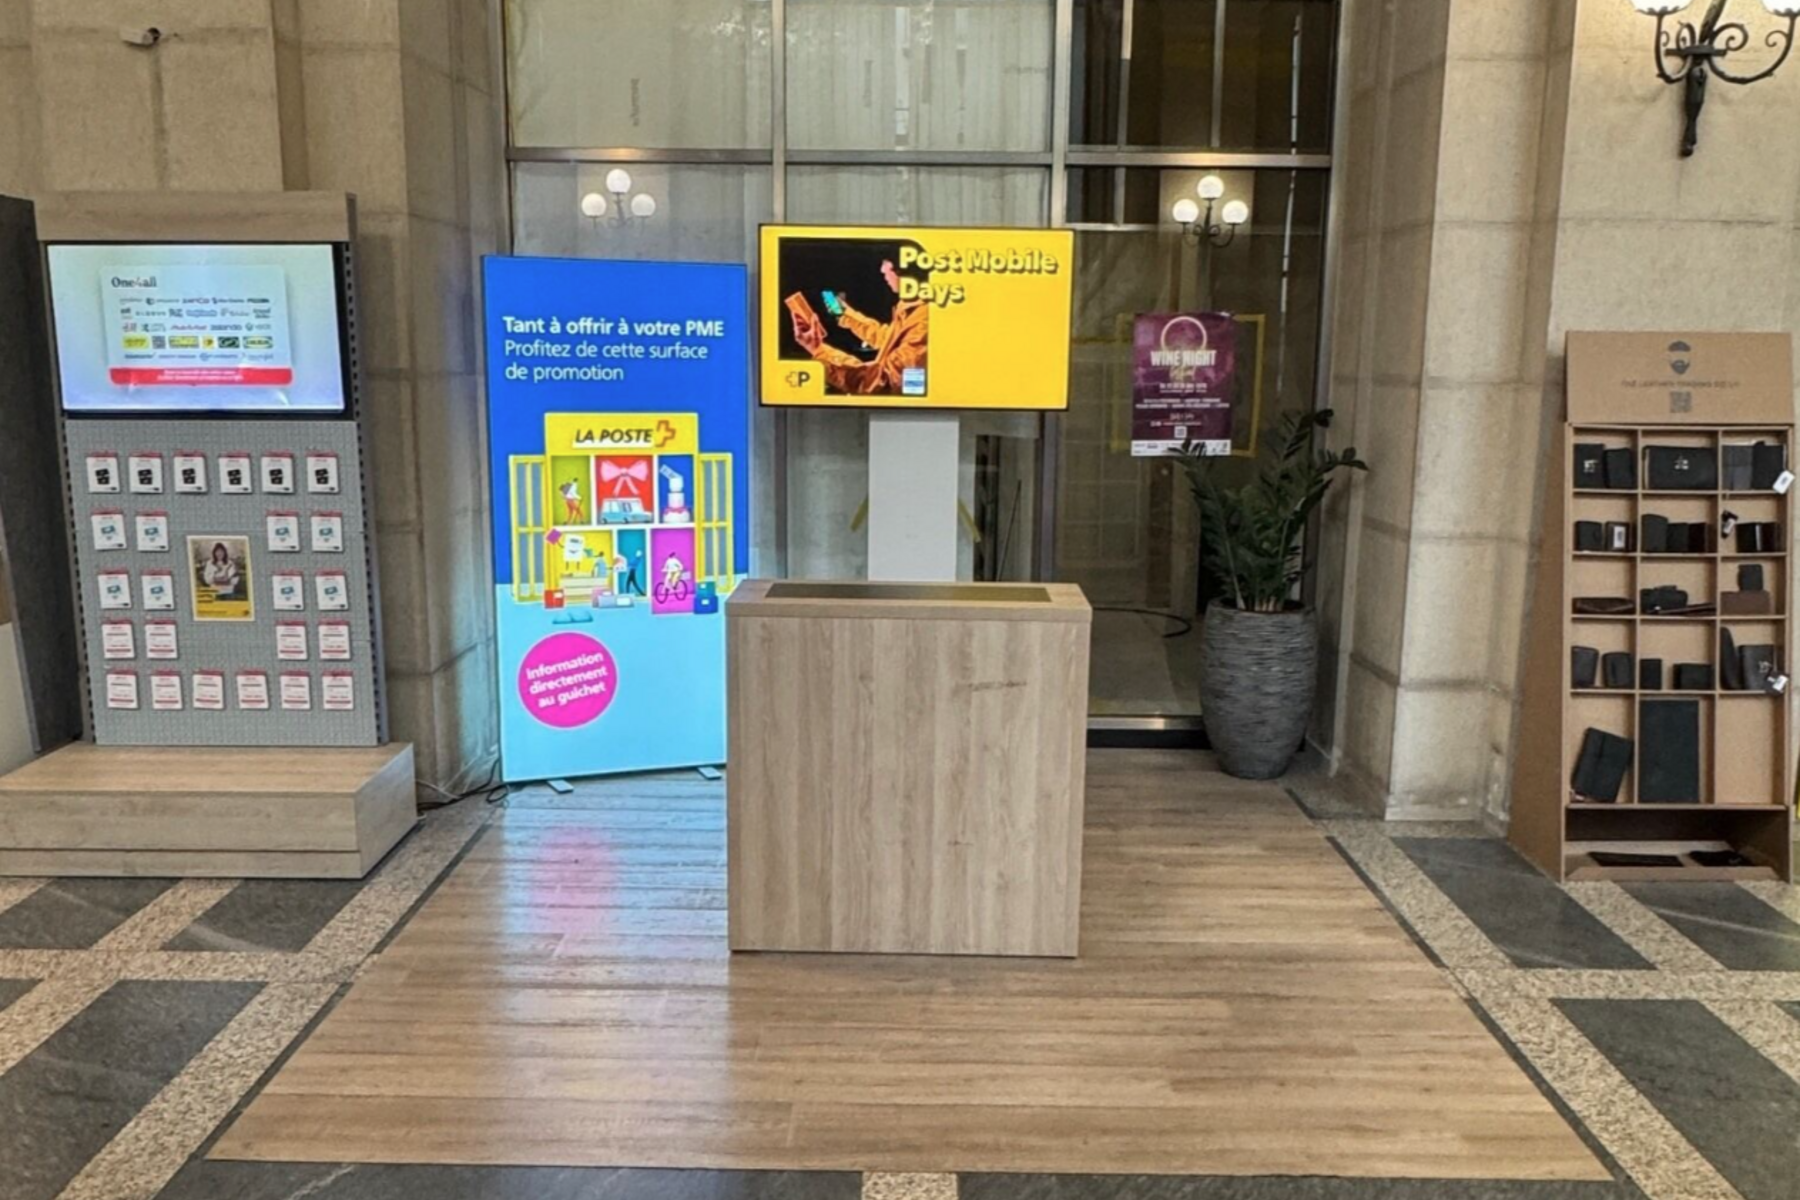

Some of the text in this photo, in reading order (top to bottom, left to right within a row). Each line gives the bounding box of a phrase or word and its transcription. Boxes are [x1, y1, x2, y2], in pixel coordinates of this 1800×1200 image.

[899, 246, 1058, 275] Post Mobile
[898, 278, 965, 308] Days
[503, 316, 724, 337] Tant à offrir à votre PME
[505, 340, 708, 359] Profitez de cette surface
[1150, 350, 1217, 366] WINE NIGHT
[505, 363, 624, 383] de promotion
[575, 427, 653, 443] LA POSTE
[526, 652, 604, 680] Information
[529, 666, 608, 694] directement
[538, 681, 607, 708] au guichet
